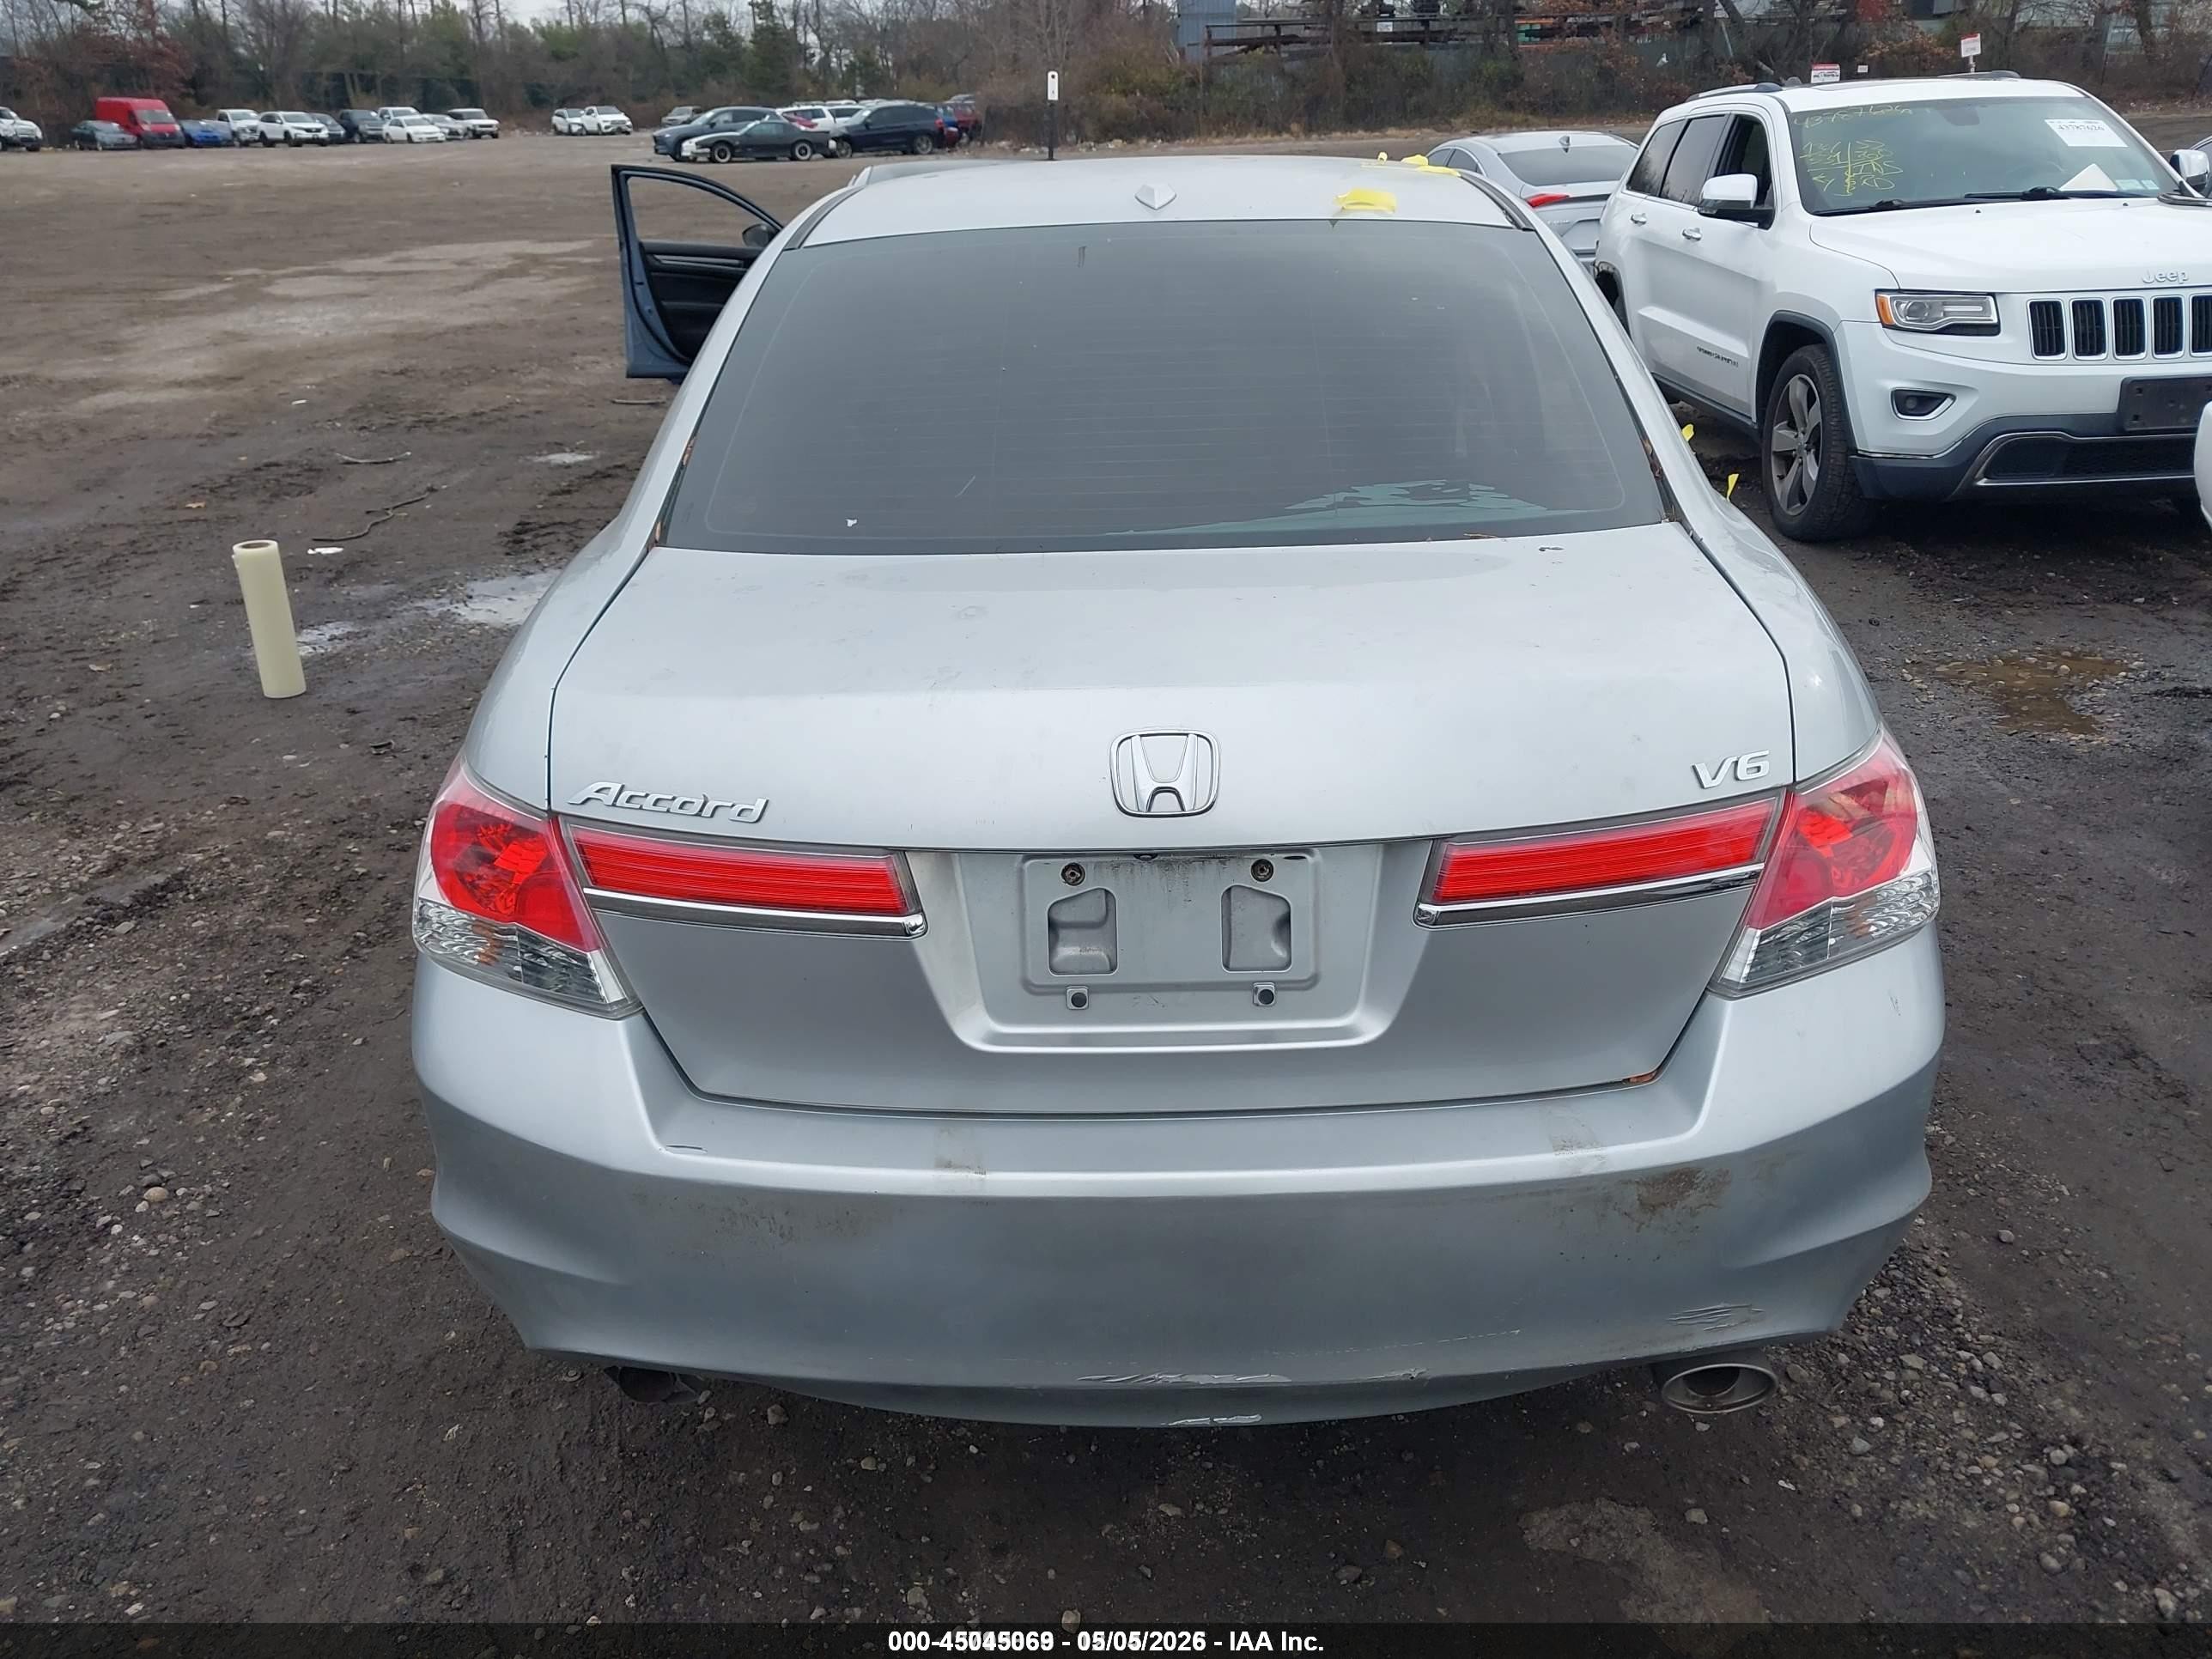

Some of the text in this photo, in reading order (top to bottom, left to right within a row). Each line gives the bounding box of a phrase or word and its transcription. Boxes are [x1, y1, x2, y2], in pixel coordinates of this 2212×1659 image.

[2142, 269, 2189, 284] Jeep
[1691, 749, 1770, 789] V6
[567, 781, 769, 824] Accord
